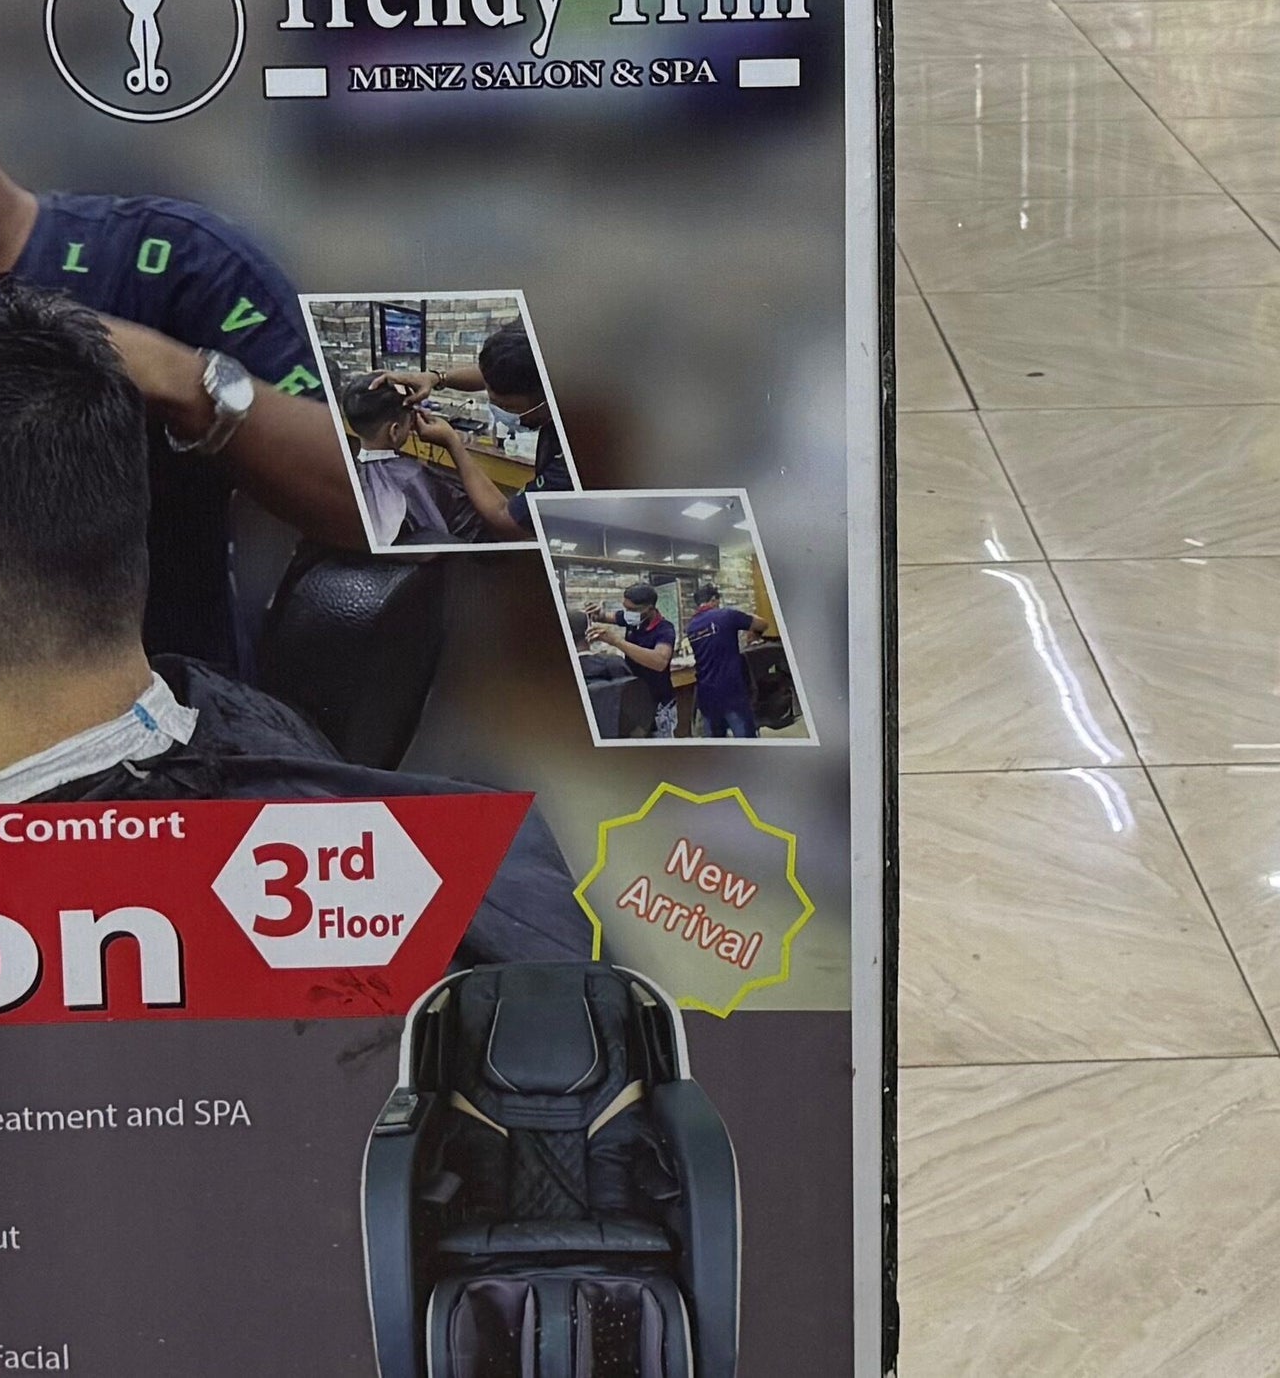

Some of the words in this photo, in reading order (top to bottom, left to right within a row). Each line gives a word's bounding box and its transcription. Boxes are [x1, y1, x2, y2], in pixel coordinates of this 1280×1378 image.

[349, 62, 466, 92] MENZ
[471, 60, 604, 90] SALON
[613, 59, 645, 87] &
[649, 59, 719, 87] SPA
[252, 831, 376, 938] 3rd
[665, 838, 758, 909] New
[318, 906, 405, 939] Floor
[617, 875, 764, 970] Arrival
[126, 1100, 184, 1128] and
[193, 1099, 252, 1127] SPA
